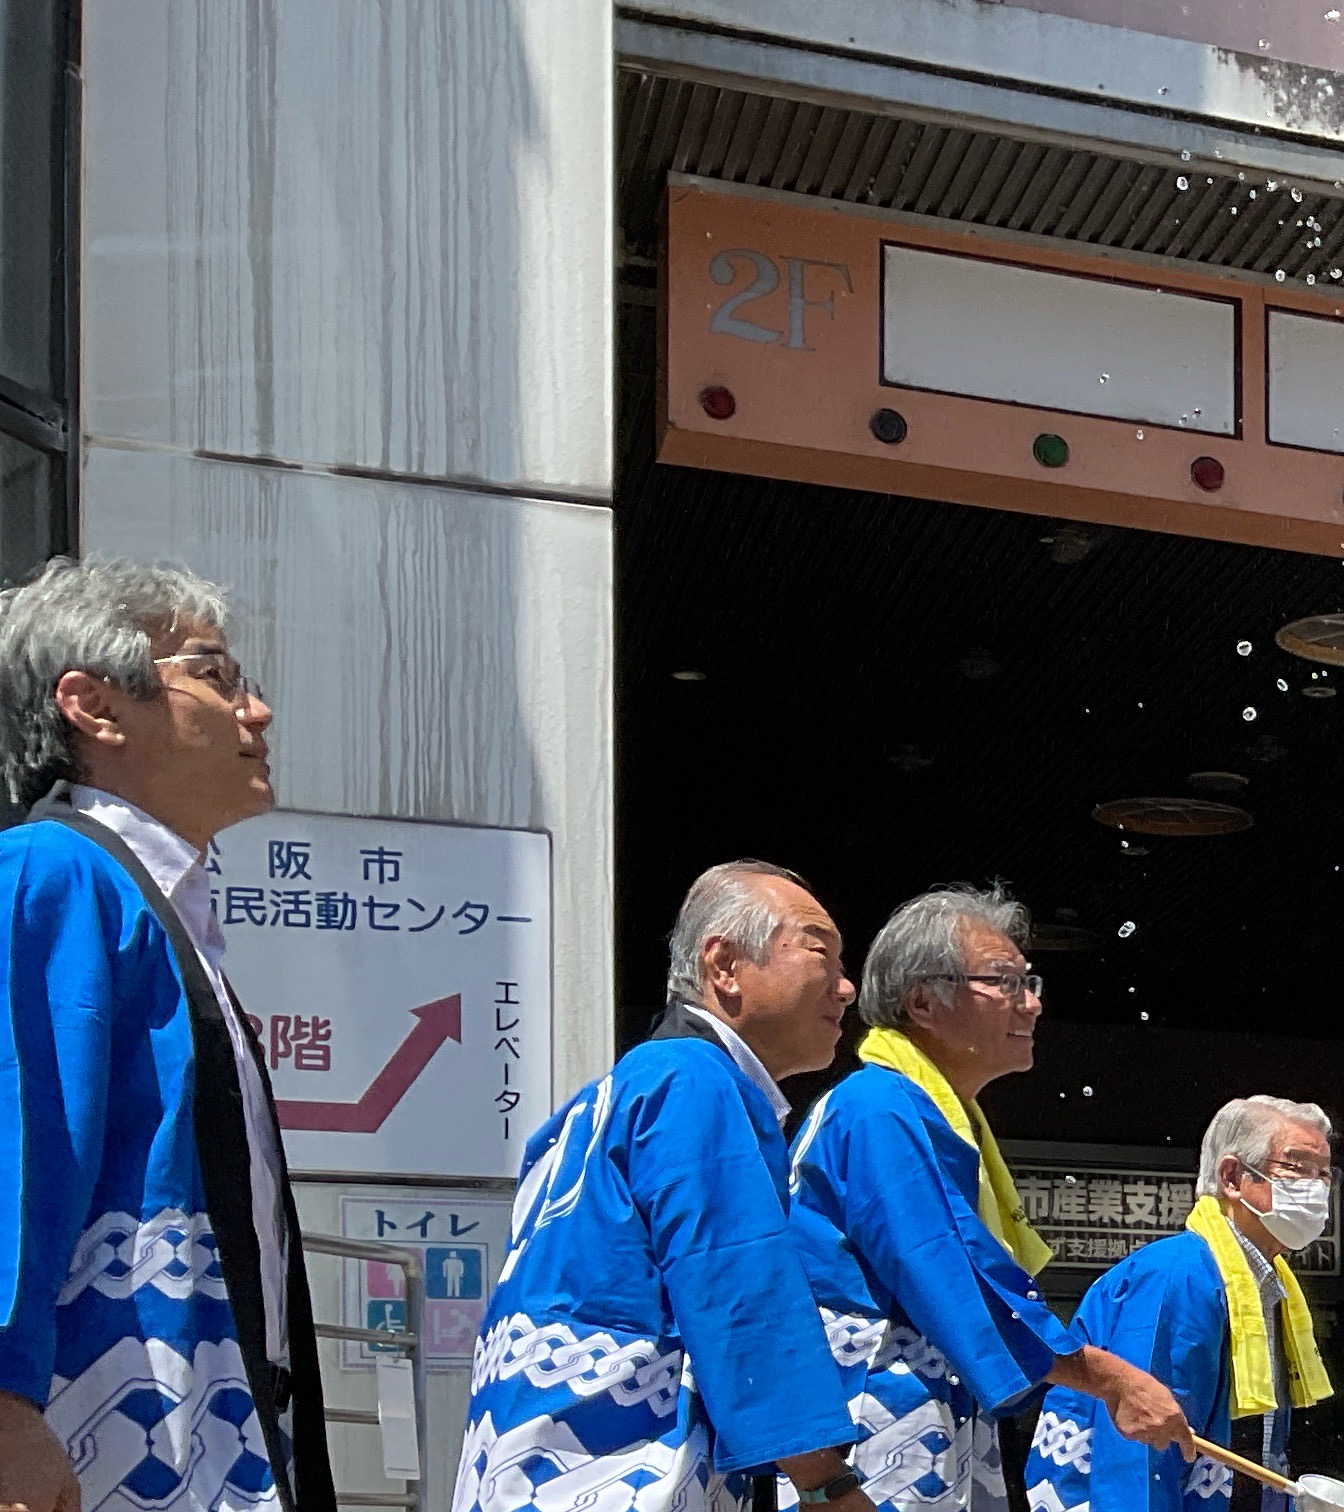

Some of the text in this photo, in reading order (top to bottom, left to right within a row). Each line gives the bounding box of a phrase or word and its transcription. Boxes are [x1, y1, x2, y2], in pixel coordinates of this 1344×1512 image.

[708, 248, 854, 352] 2F
[494, 981, 520, 1140] エレベーター
[374, 1209, 480, 1238] トイレ
